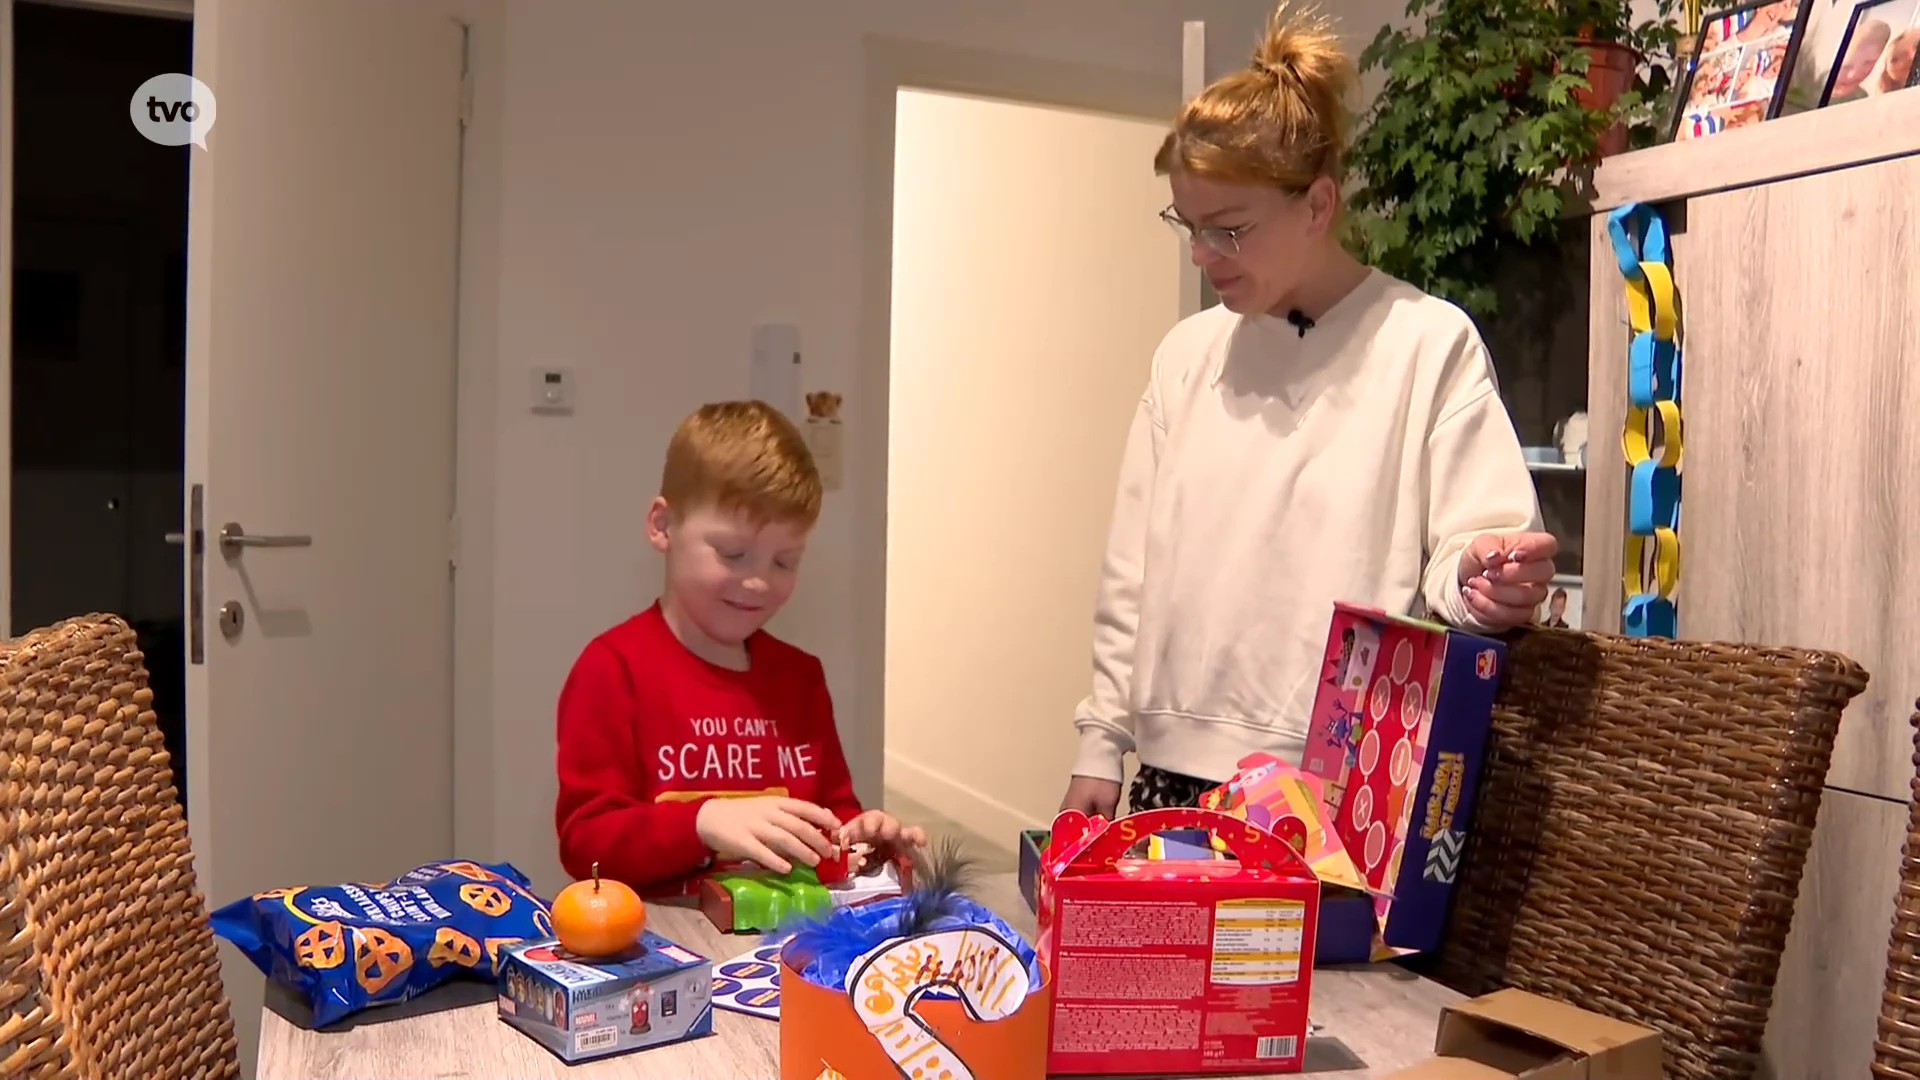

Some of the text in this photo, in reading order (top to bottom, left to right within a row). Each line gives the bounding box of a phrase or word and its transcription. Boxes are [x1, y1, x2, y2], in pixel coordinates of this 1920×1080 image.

[690, 717, 779, 737] YOU CAN'T
[658, 743, 816, 781] SCARE ME
[1119, 820, 1137, 841] S
[1244, 824, 1260, 843] S
